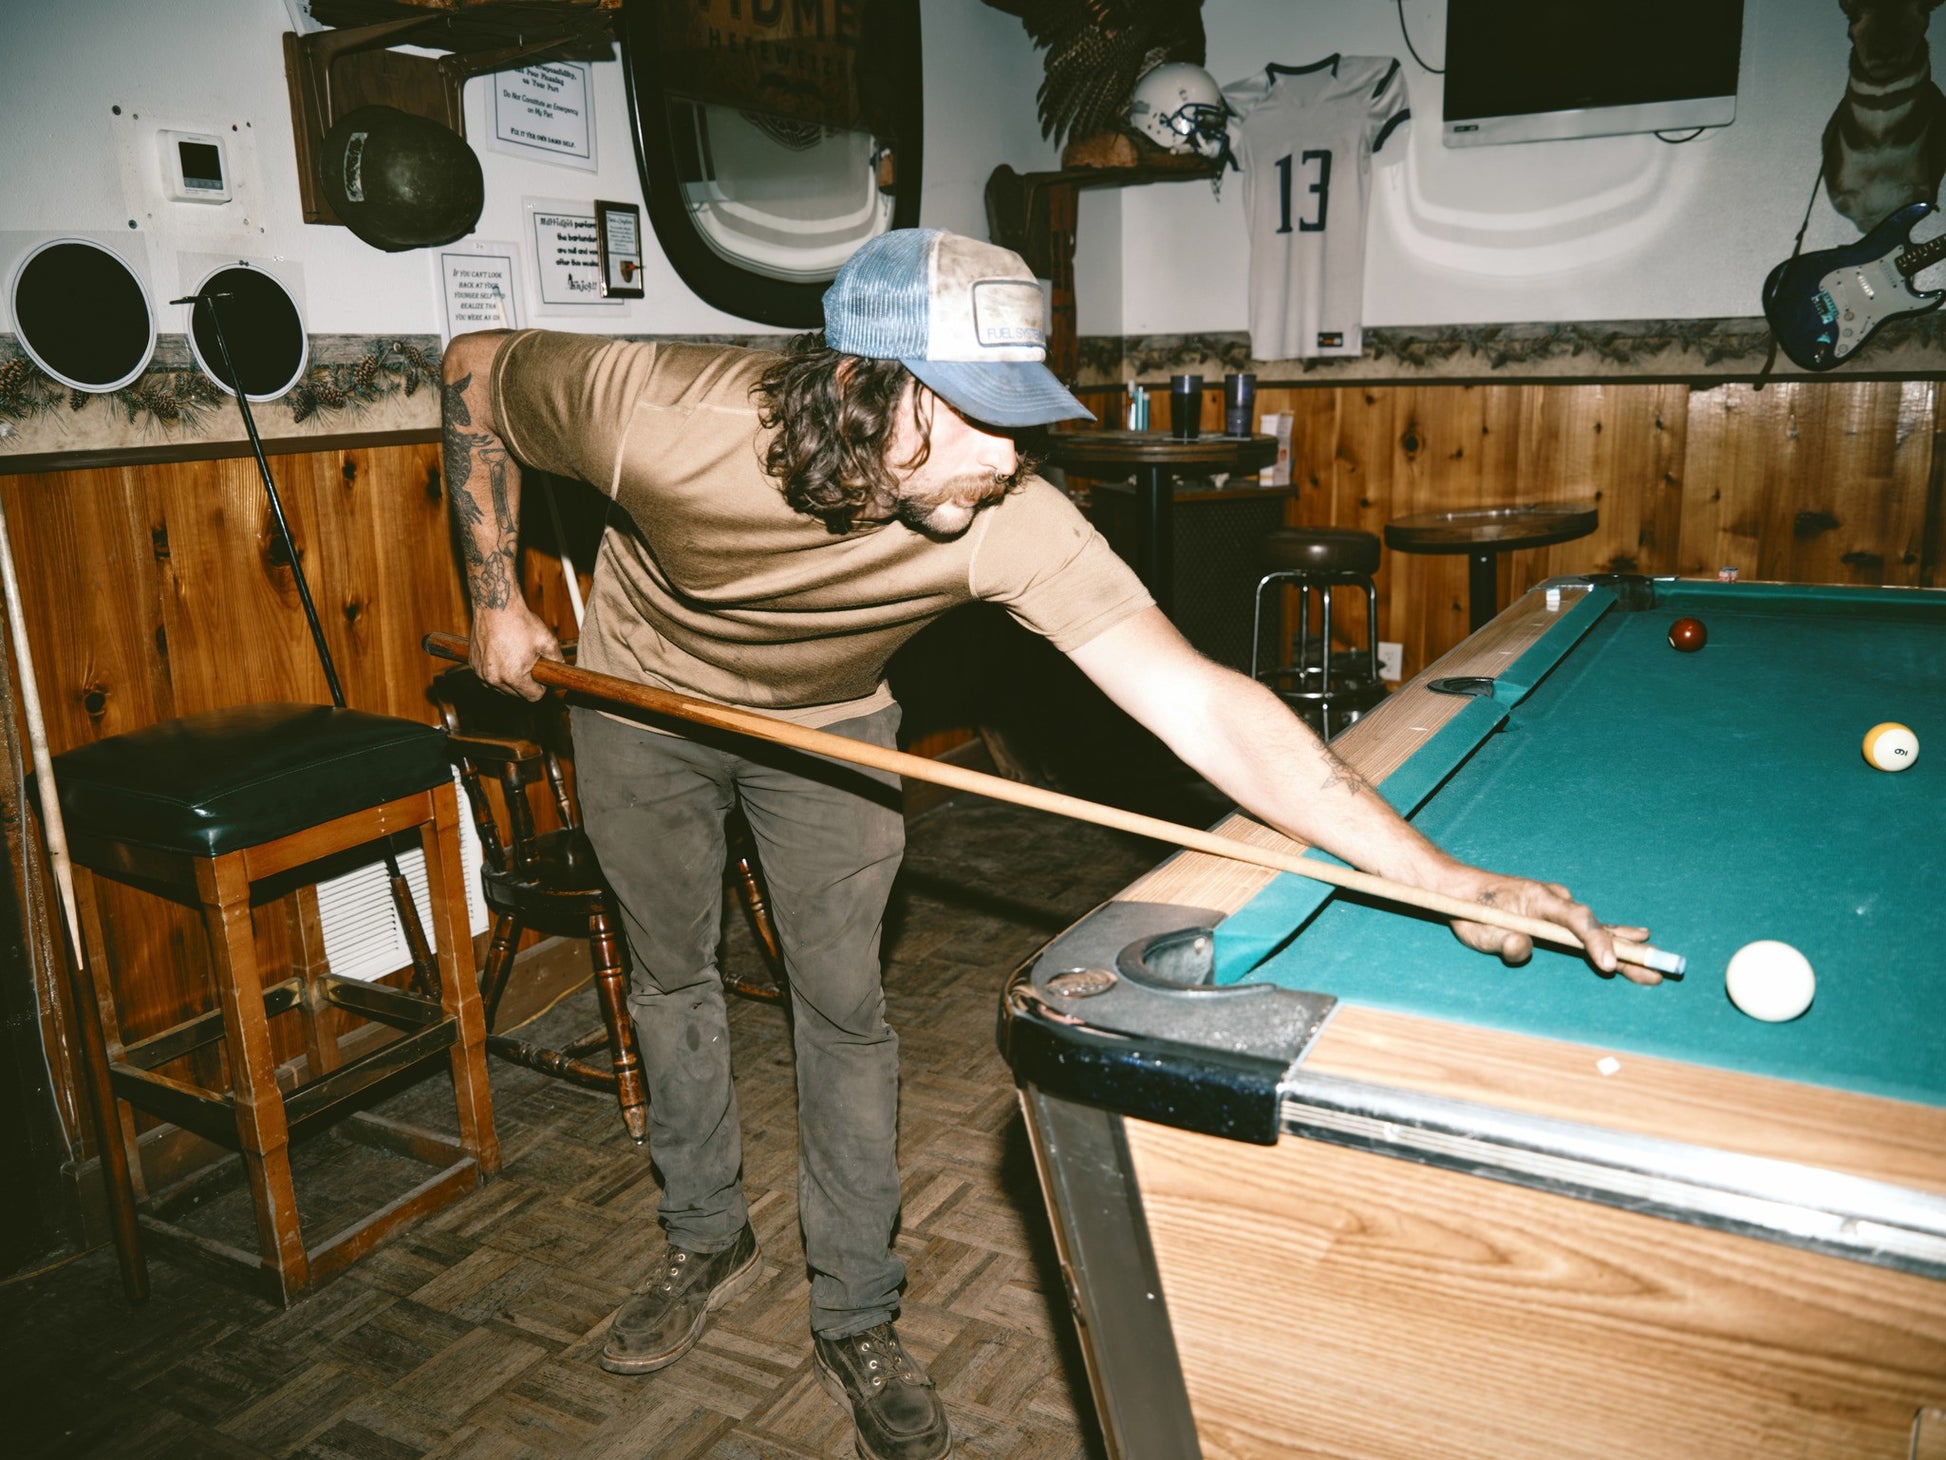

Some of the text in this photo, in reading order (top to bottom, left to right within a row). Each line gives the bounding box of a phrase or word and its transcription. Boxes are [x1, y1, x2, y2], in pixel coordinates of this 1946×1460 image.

[503, 89, 511, 97] Do
[512, 92, 521, 100] Not
[522, 94, 545, 107] Constitute
[553, 103, 578, 116] Emergency
[1275, 149, 1332, 234] 13
[987, 327, 1014, 340] FUEL
